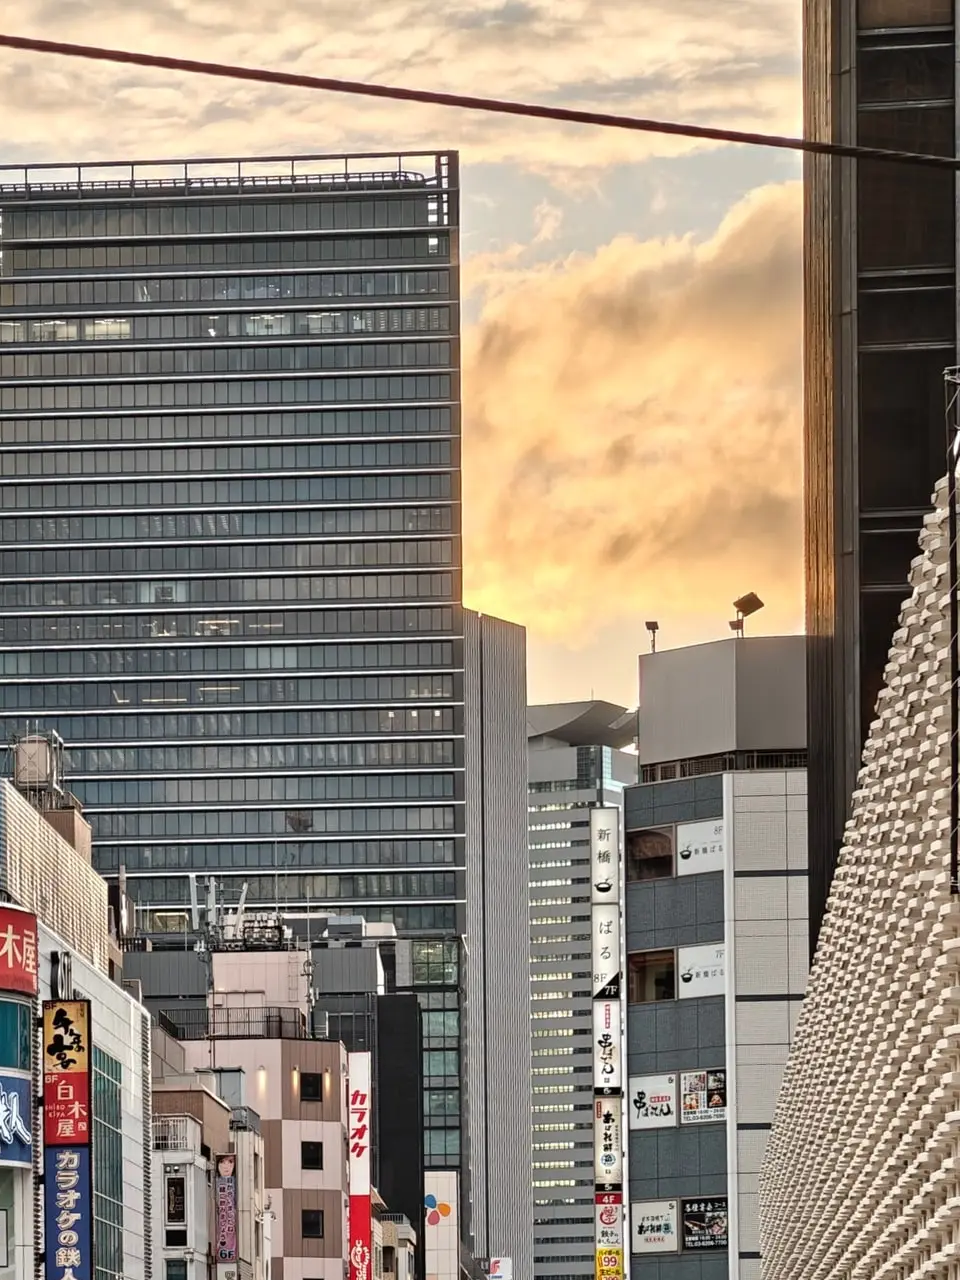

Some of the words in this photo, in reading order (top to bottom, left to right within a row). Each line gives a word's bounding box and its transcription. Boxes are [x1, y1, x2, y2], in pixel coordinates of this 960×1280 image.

[593, 973, 607, 983] 8F
[604, 985, 618, 995] 7F
[56, 1080, 88, 1138] 白木屋
[350, 1090, 368, 1158] カラオケ
[219, 1249, 234, 1259] 6F
[603, 1256, 617, 1268] 99
